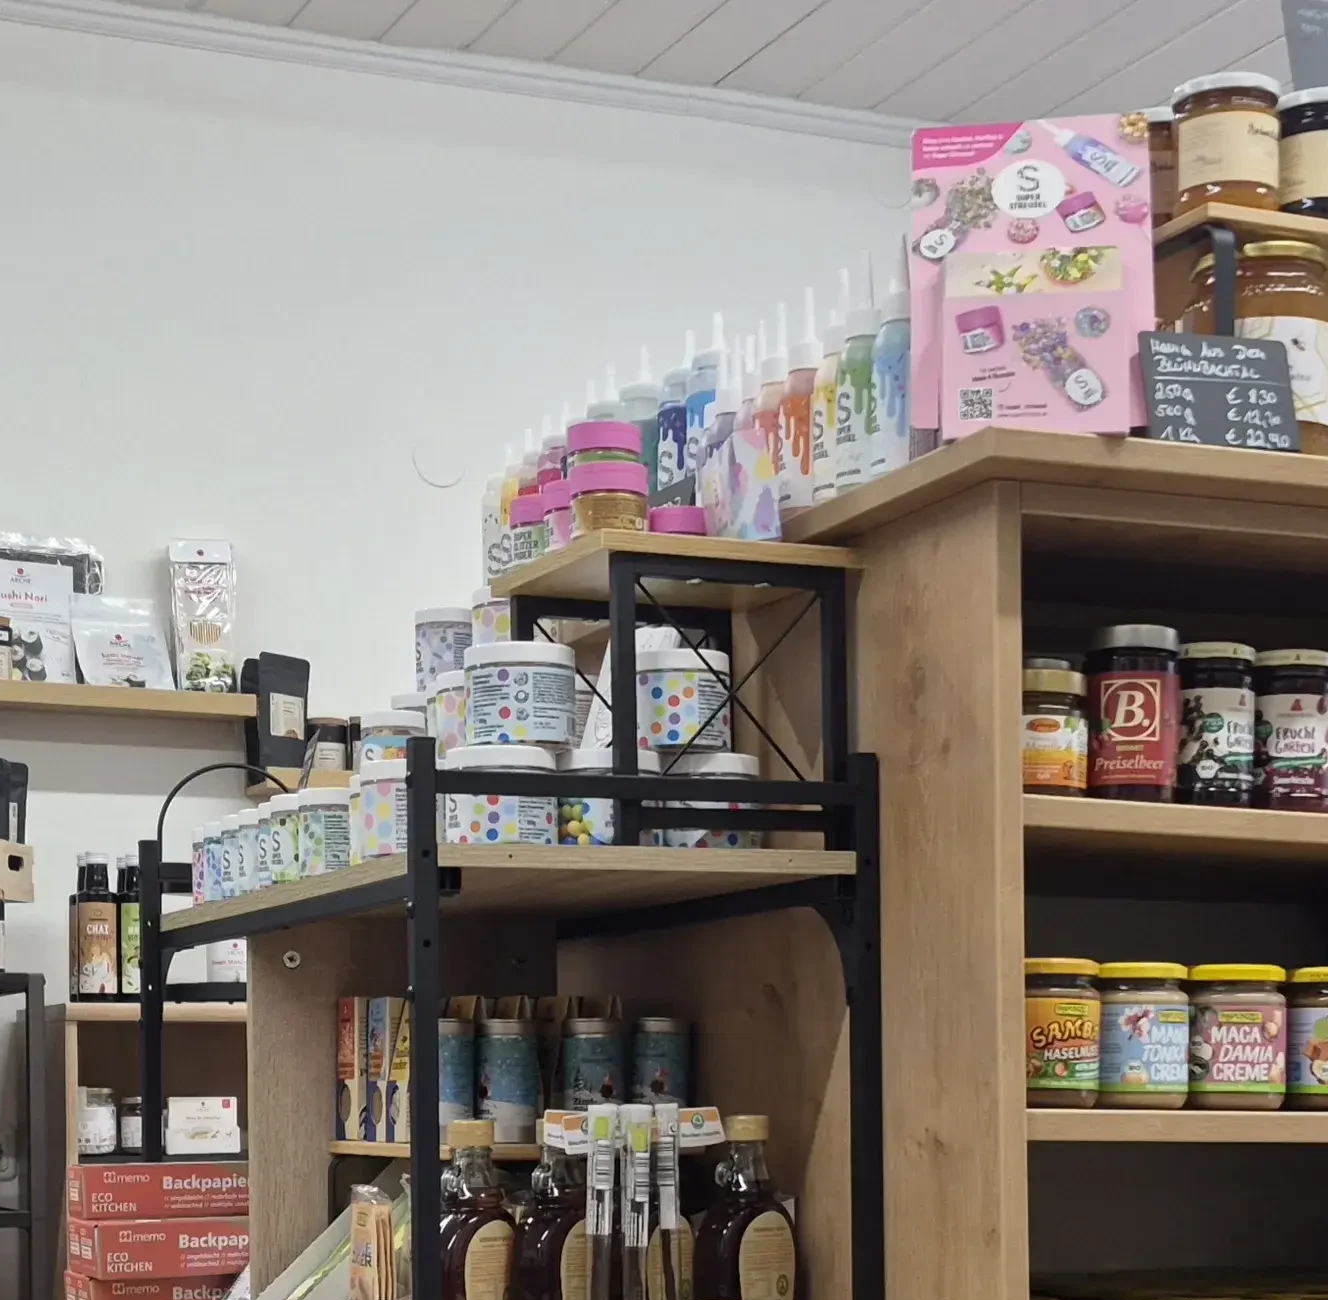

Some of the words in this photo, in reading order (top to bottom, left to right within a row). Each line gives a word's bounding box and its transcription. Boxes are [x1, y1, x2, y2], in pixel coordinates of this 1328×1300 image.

[24, 592, 48, 603] Nori
[1111, 690, 1150, 729] B.
[86, 923, 109, 936] CHAI
[1210, 1026, 1262, 1044] MACA
[1220, 1045, 1274, 1062] DAMIA
[1212, 1063, 1270, 1082] CREME
[117, 1173, 150, 1184] memo
[162, 1173, 249, 1192] Backpapie
[91, 1193, 113, 1203] ECO
[91, 1203, 137, 1213] KITCHEN
[132, 1232, 166, 1242] memo
[107, 1252, 129, 1262] ECO
[107, 1262, 153, 1273] KITCHEN
[126, 1284, 160, 1294] memo
